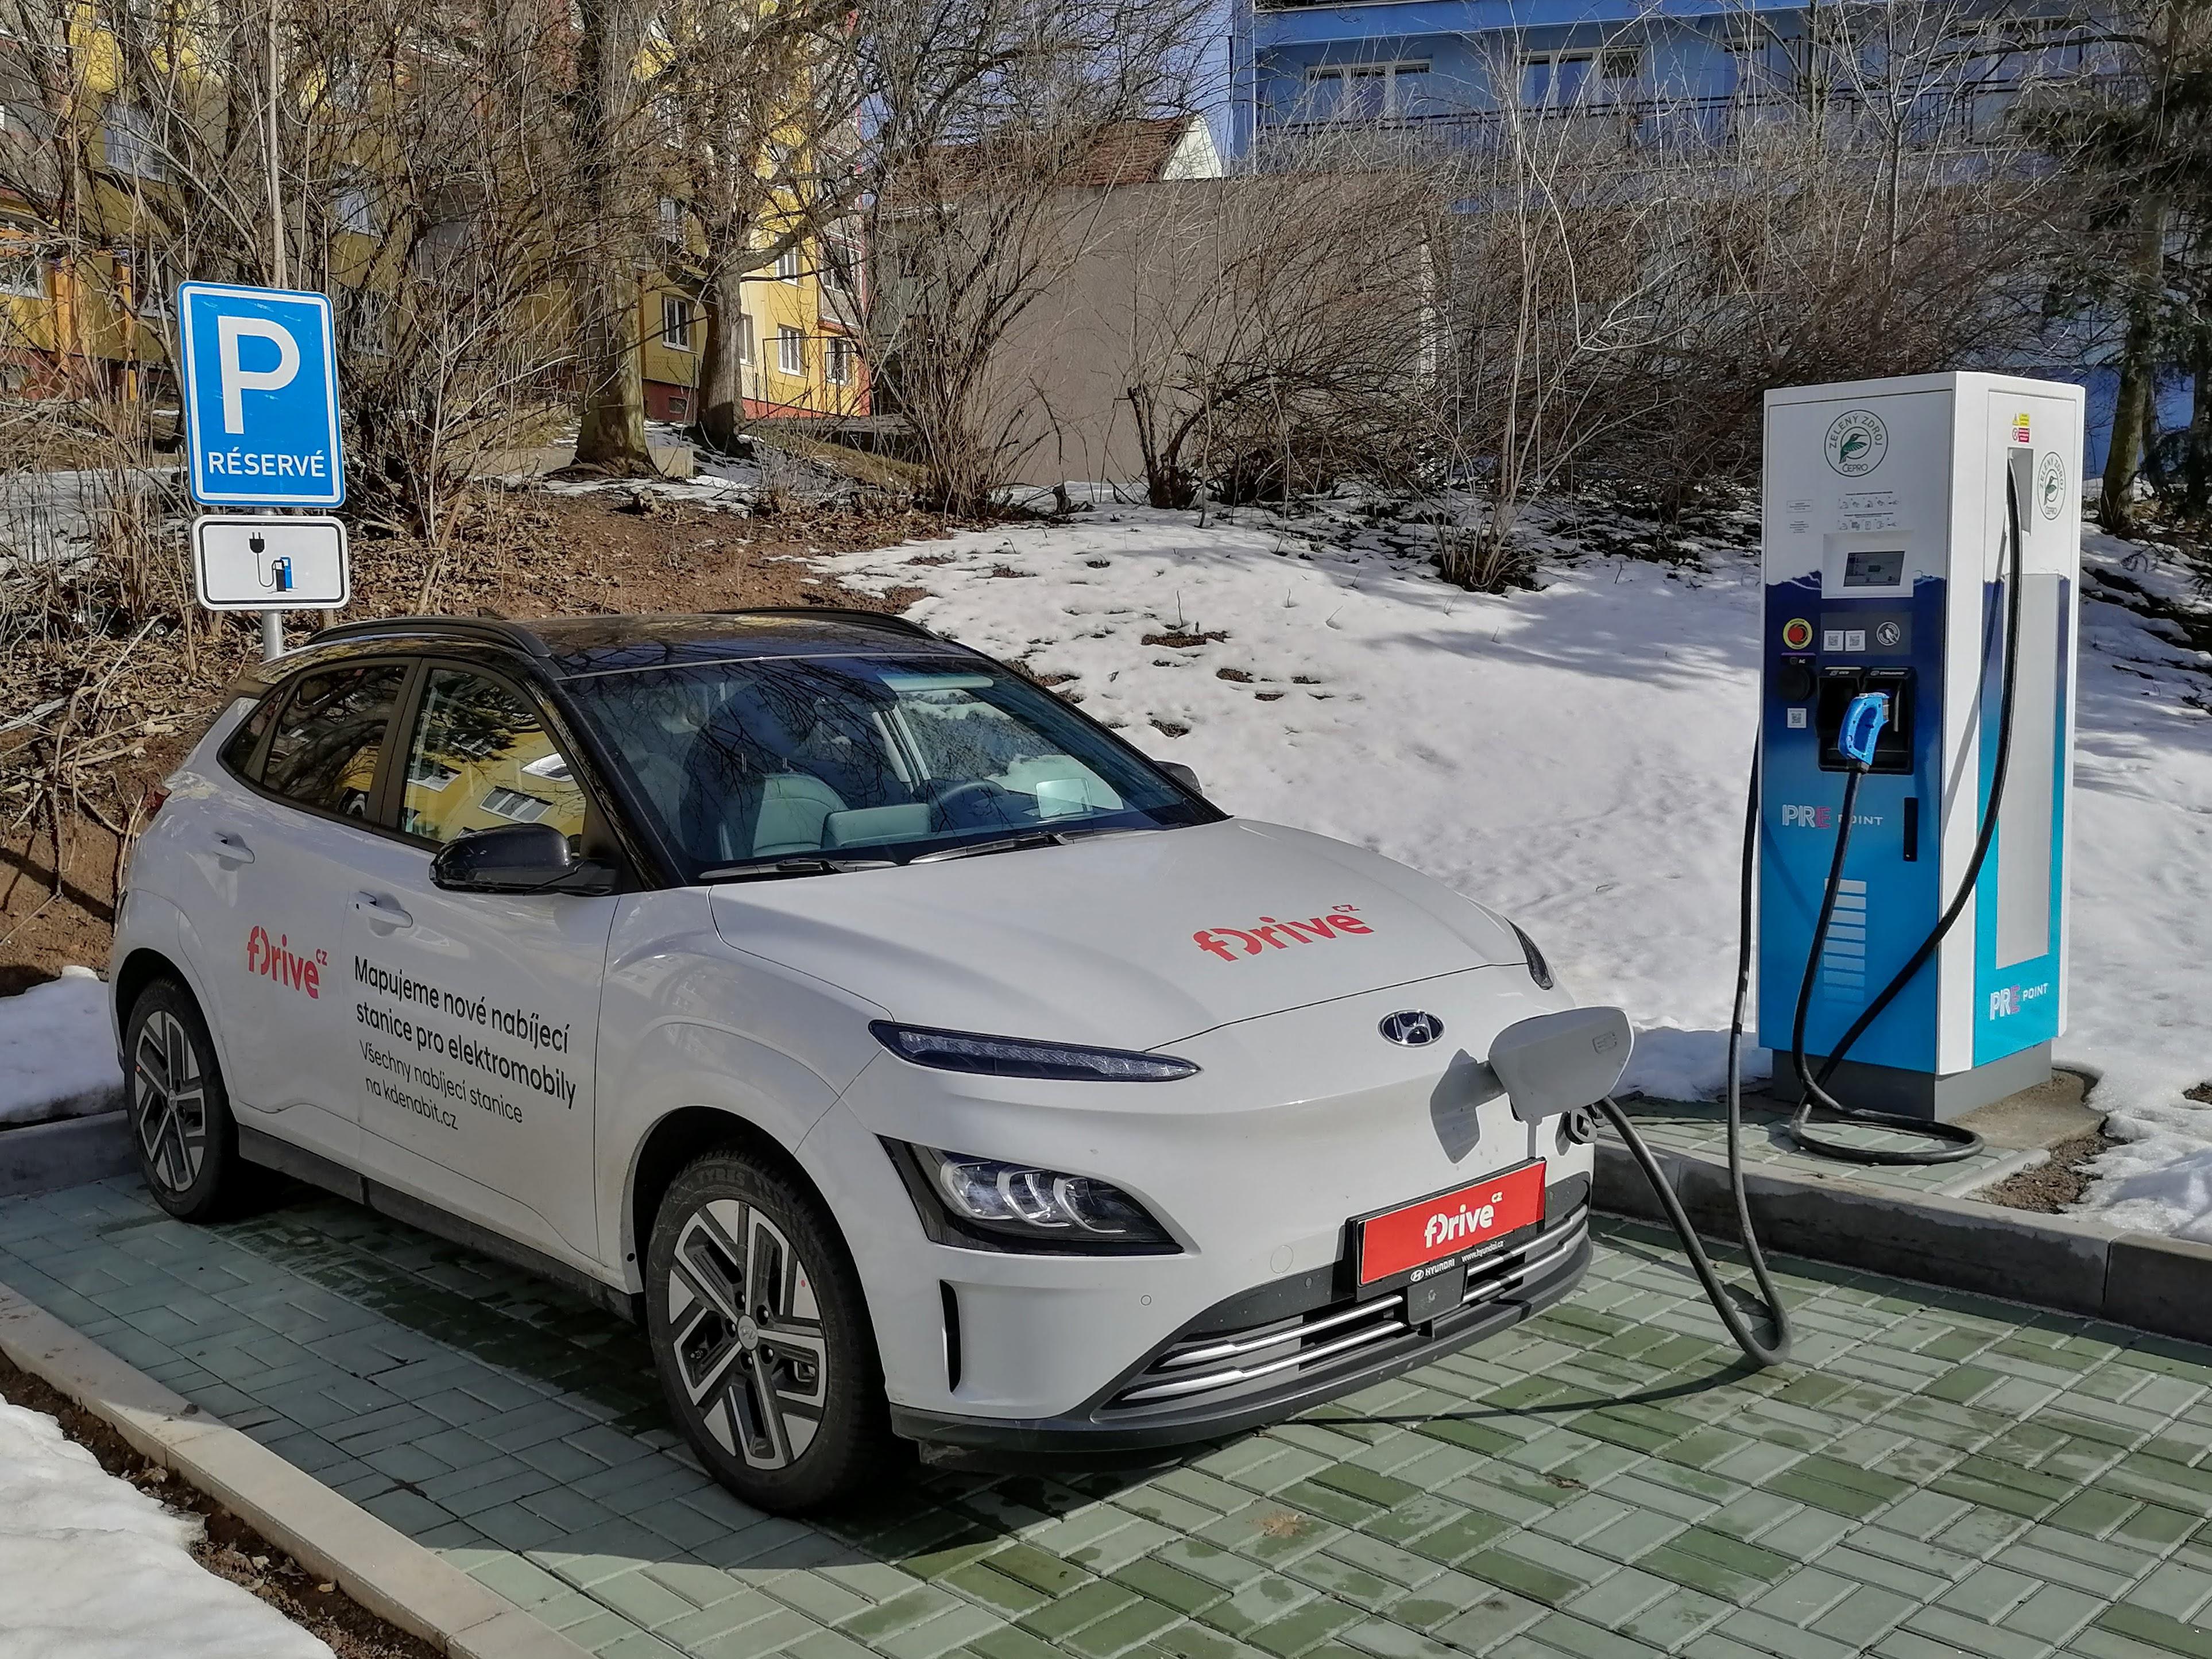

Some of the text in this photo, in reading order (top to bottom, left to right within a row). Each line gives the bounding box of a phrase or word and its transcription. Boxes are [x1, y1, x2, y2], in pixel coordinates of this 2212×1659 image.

[218, 316, 300, 434] P
[1829, 413, 1883, 448] ZELENÝ ZDROJ
[208, 447, 326, 477] RÉSERVÉ
[1782, 804, 1831, 829] PRE
[355, 956, 570, 1053] Mapujeme nové nabíjecí
[1990, 983, 2048, 1020] PRE POINT
[357, 1002, 575, 1109] stanice pro elektromobily
[359, 1039, 522, 1123] Všechny nabíjecí stanice
[366, 1077, 458, 1130] na kdenabit.cz
[1425, 1258, 1455, 1277] HYUNDAI
